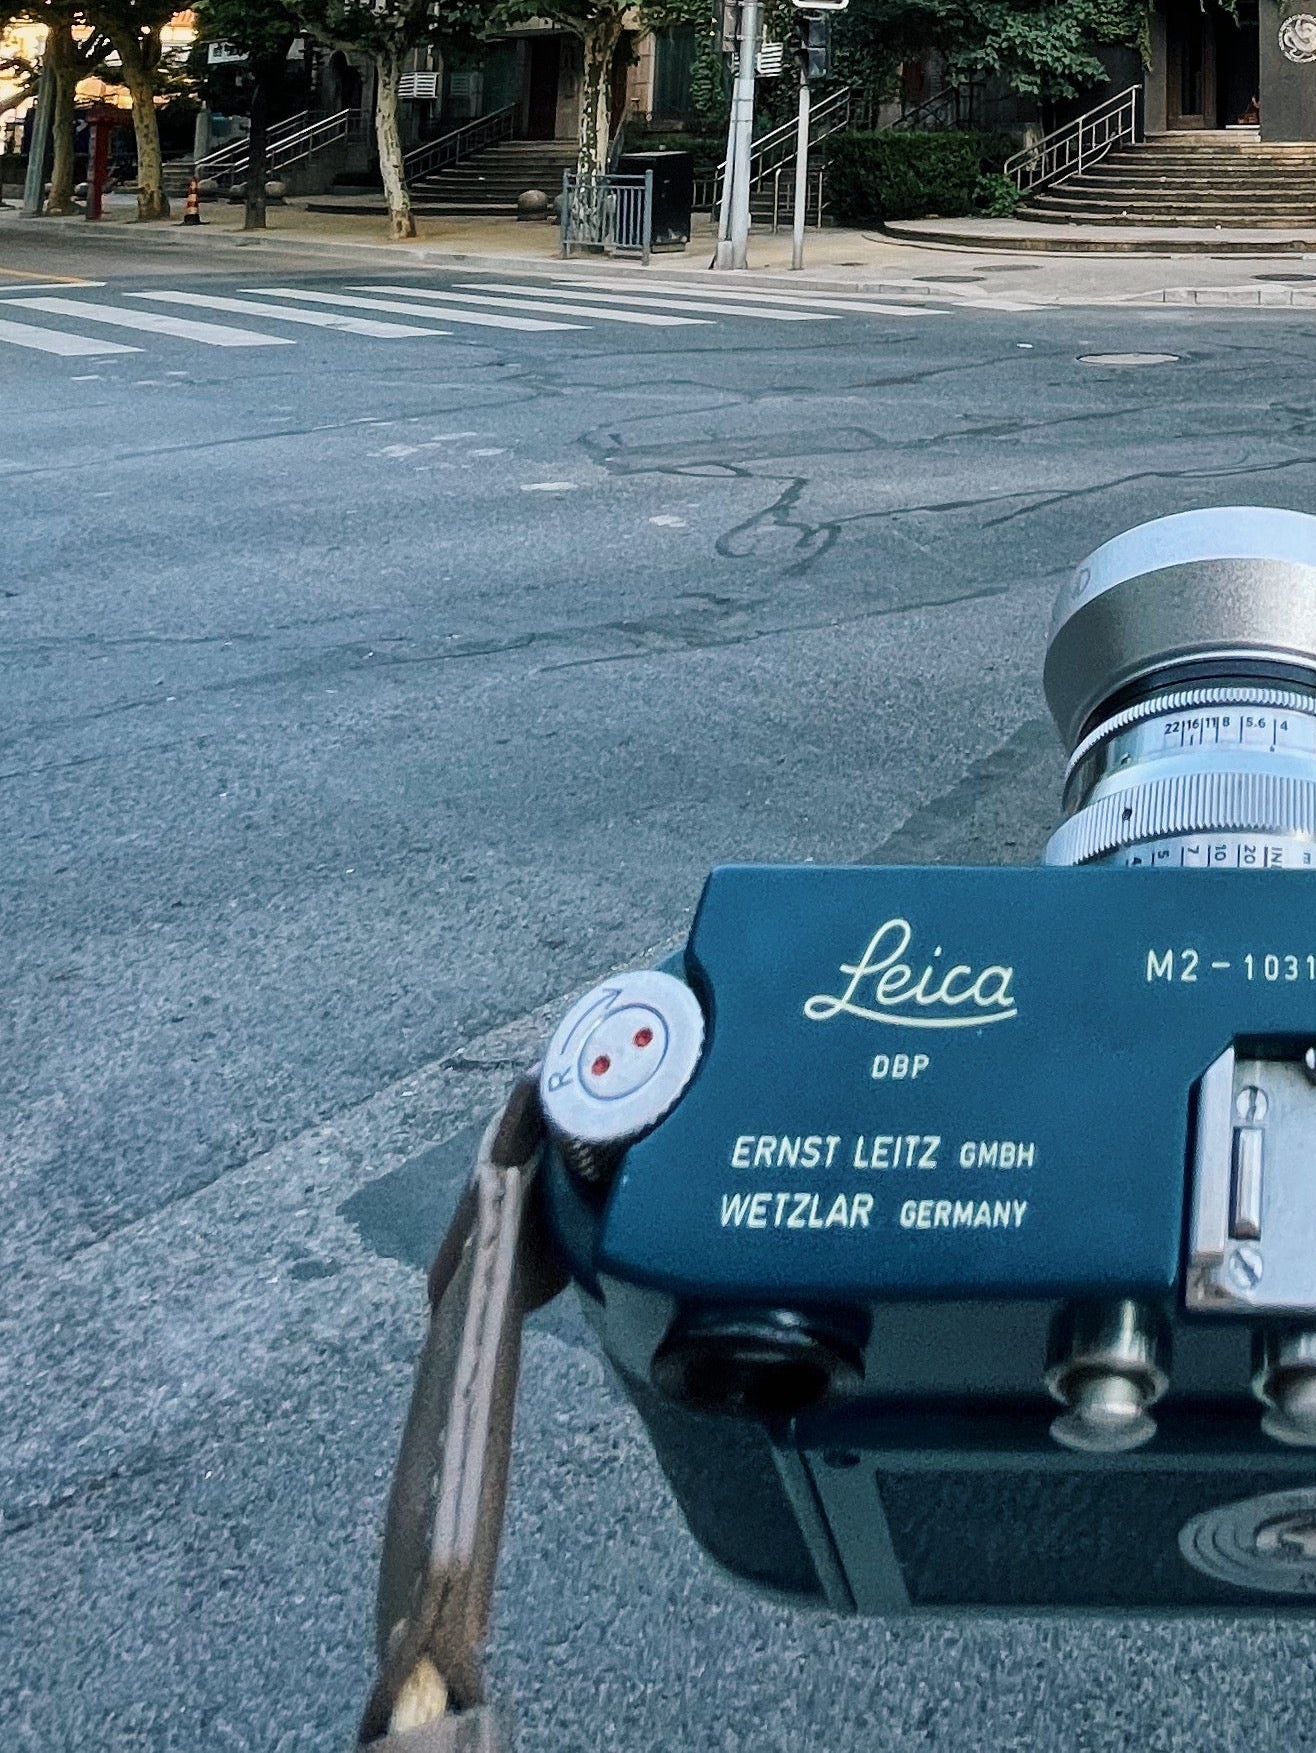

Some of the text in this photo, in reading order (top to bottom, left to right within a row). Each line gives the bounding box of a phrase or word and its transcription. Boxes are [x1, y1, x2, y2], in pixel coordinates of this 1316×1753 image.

[1164, 721, 1180, 735] 22
[1187, 719, 1199, 730] 16
[1222, 717, 1230, 727] 8
[1246, 719, 1266, 730] 5.6
[1280, 720, 1289, 732] 4
[1158, 850, 1170, 860] 5
[1187, 846, 1200, 855] 7
[1215, 845, 1227, 862] 10
[1244, 845, 1256, 865] 20
[803, 918, 1018, 1028] Leica
[548, 1066, 574, 1092] R
[871, 1054, 930, 1079] DBP
[730, 1135, 1036, 1169] ERNST LEITZ GMBH
[720, 1192, 1028, 1229] WETZLAR GERMANY
